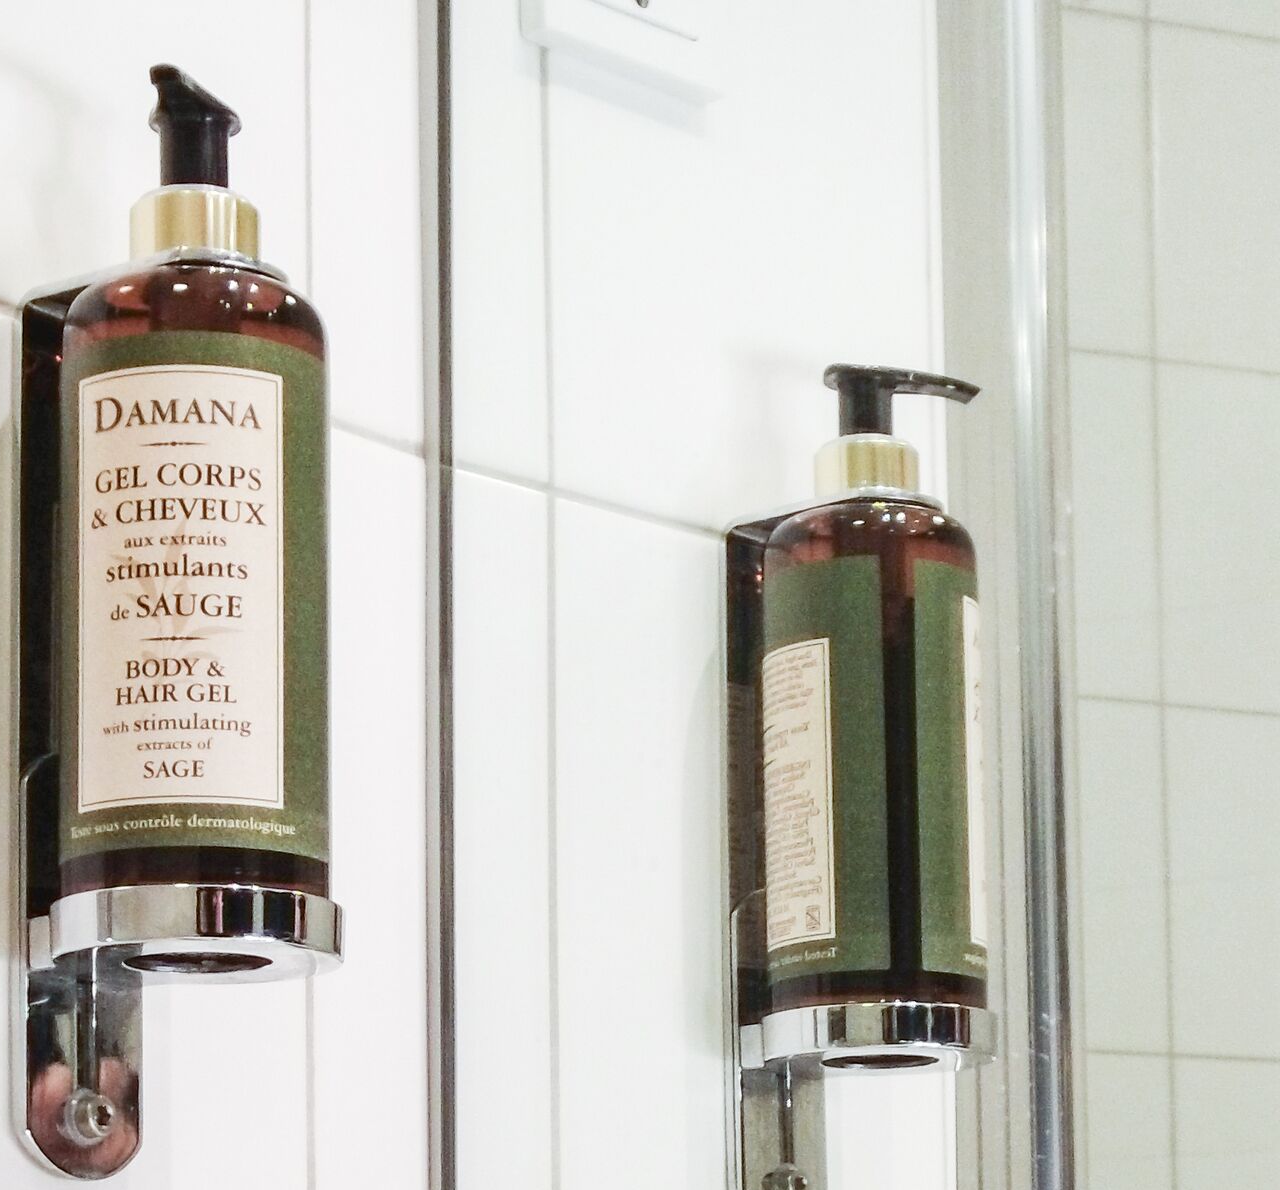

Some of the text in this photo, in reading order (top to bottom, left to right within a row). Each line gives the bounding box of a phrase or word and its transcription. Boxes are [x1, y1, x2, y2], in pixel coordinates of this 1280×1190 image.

[95, 397, 262, 433] DAMANA
[95, 462, 262, 493] GEL CORPS
[91, 497, 268, 530] & CHEVEUX
[124, 532, 227, 548] aux extraits
[106, 554, 248, 583] stimulants
[110, 593, 242, 621] de SAUGE
[125, 658, 225, 679] BODY &
[115, 683, 237, 706] HAIR GEL
[102, 712, 252, 737] with stimulating
[137, 737, 213, 751] extracts of
[143, 760, 205, 779] SAGE
[95, 821, 120, 835] sous
[123, 814, 184, 830] contrôle
[187, 813, 296, 837] dermatologique
